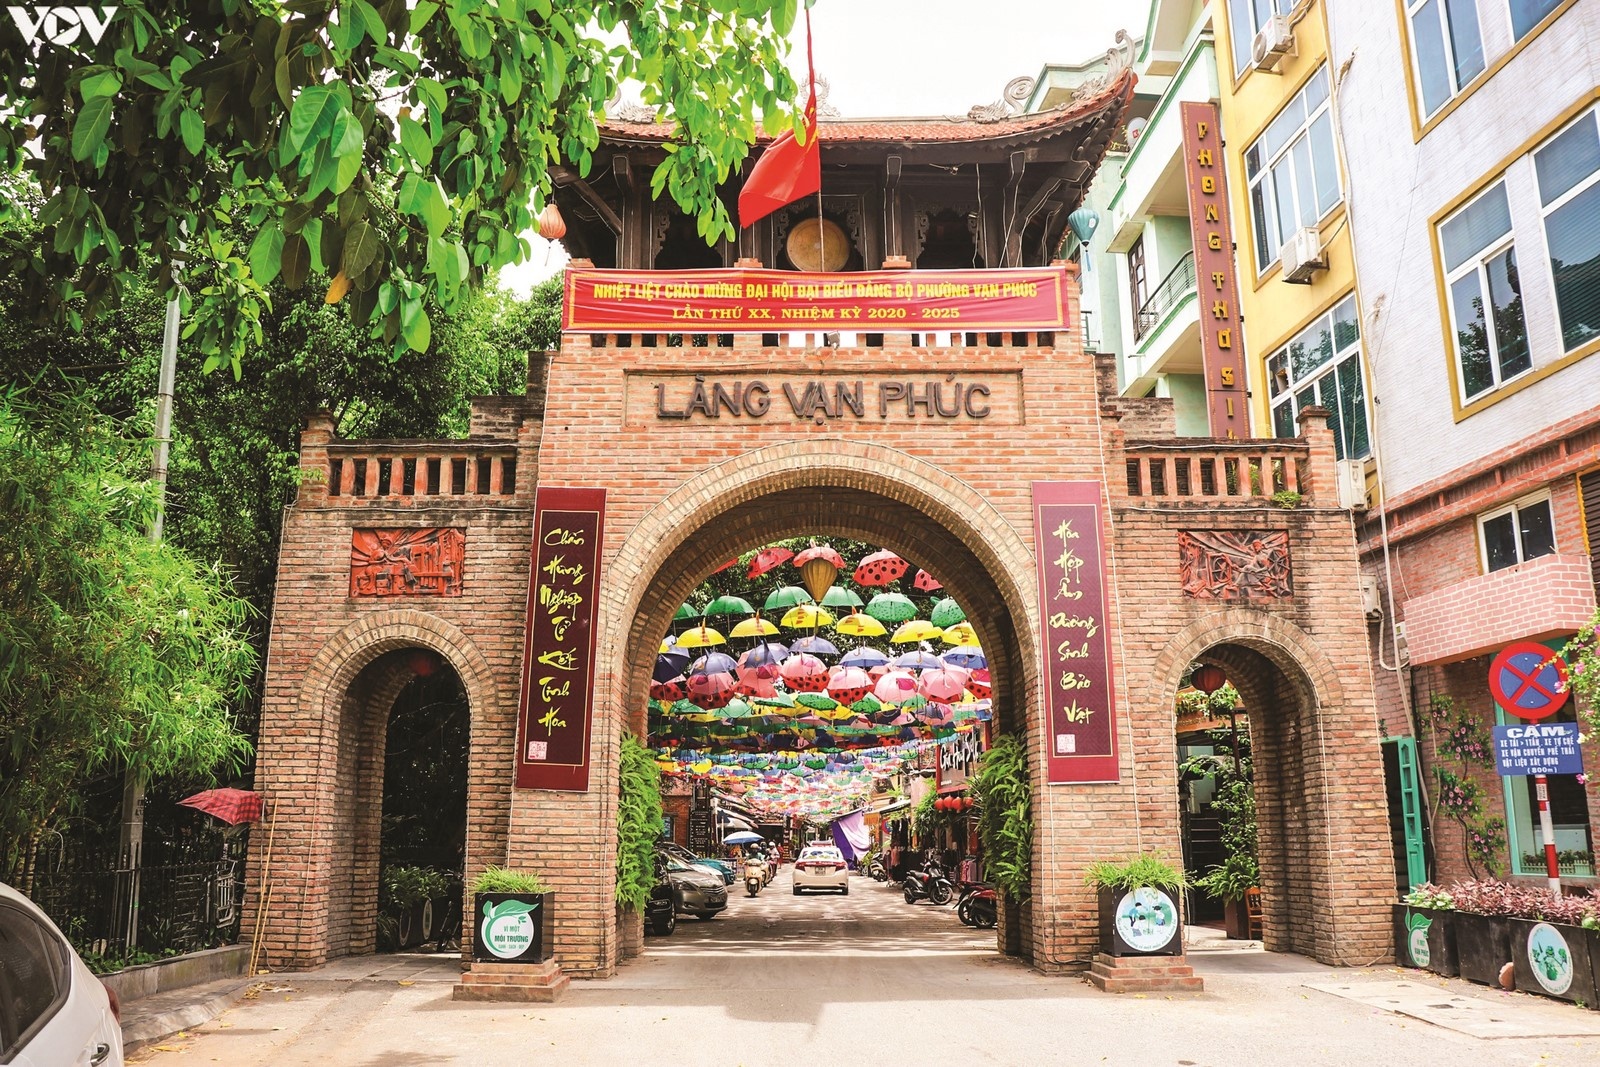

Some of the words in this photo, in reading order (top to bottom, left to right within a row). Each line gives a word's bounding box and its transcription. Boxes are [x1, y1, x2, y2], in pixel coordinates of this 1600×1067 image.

[1197, 121, 1222, 251] PHONG
[594, 281, 631, 301] NHIỆT
[635, 281, 661, 301] LIỆT
[664, 281, 699, 299] CHÀO
[704, 281, 742, 299] MỪNG
[746, 283, 768, 301] ĐẠI
[772, 282, 793, 301] HỘI
[797, 283, 819, 301] ĐẠI
[823, 279, 852, 298] BIỂU
[856, 281, 892, 298] ĐẢNG
[896, 281, 913, 301] BỘ
[917, 282, 970, 298] PHƯỜNG
[973, 283, 999, 300] VẠN
[1003, 280, 1038, 298] PHÚC
[672, 303, 704, 319] LẦN
[709, 305, 743, 319] THỨ
[748, 308, 776, 320] XX,
[781, 306, 835, 320] NHIỆM
[840, 306, 862, 319] KỲ
[868, 308, 907, 319] 2020
[922, 308, 960, 319] 2025
[657, 372, 772, 418] LÀNG
[782, 380, 865, 425] VẠN
[880, 372, 991, 418] PHÚC
[1058, 640, 1089, 661] Sinh
[1060, 670, 1091, 690] Bảo
[1506, 724, 1565, 738] CẤM
